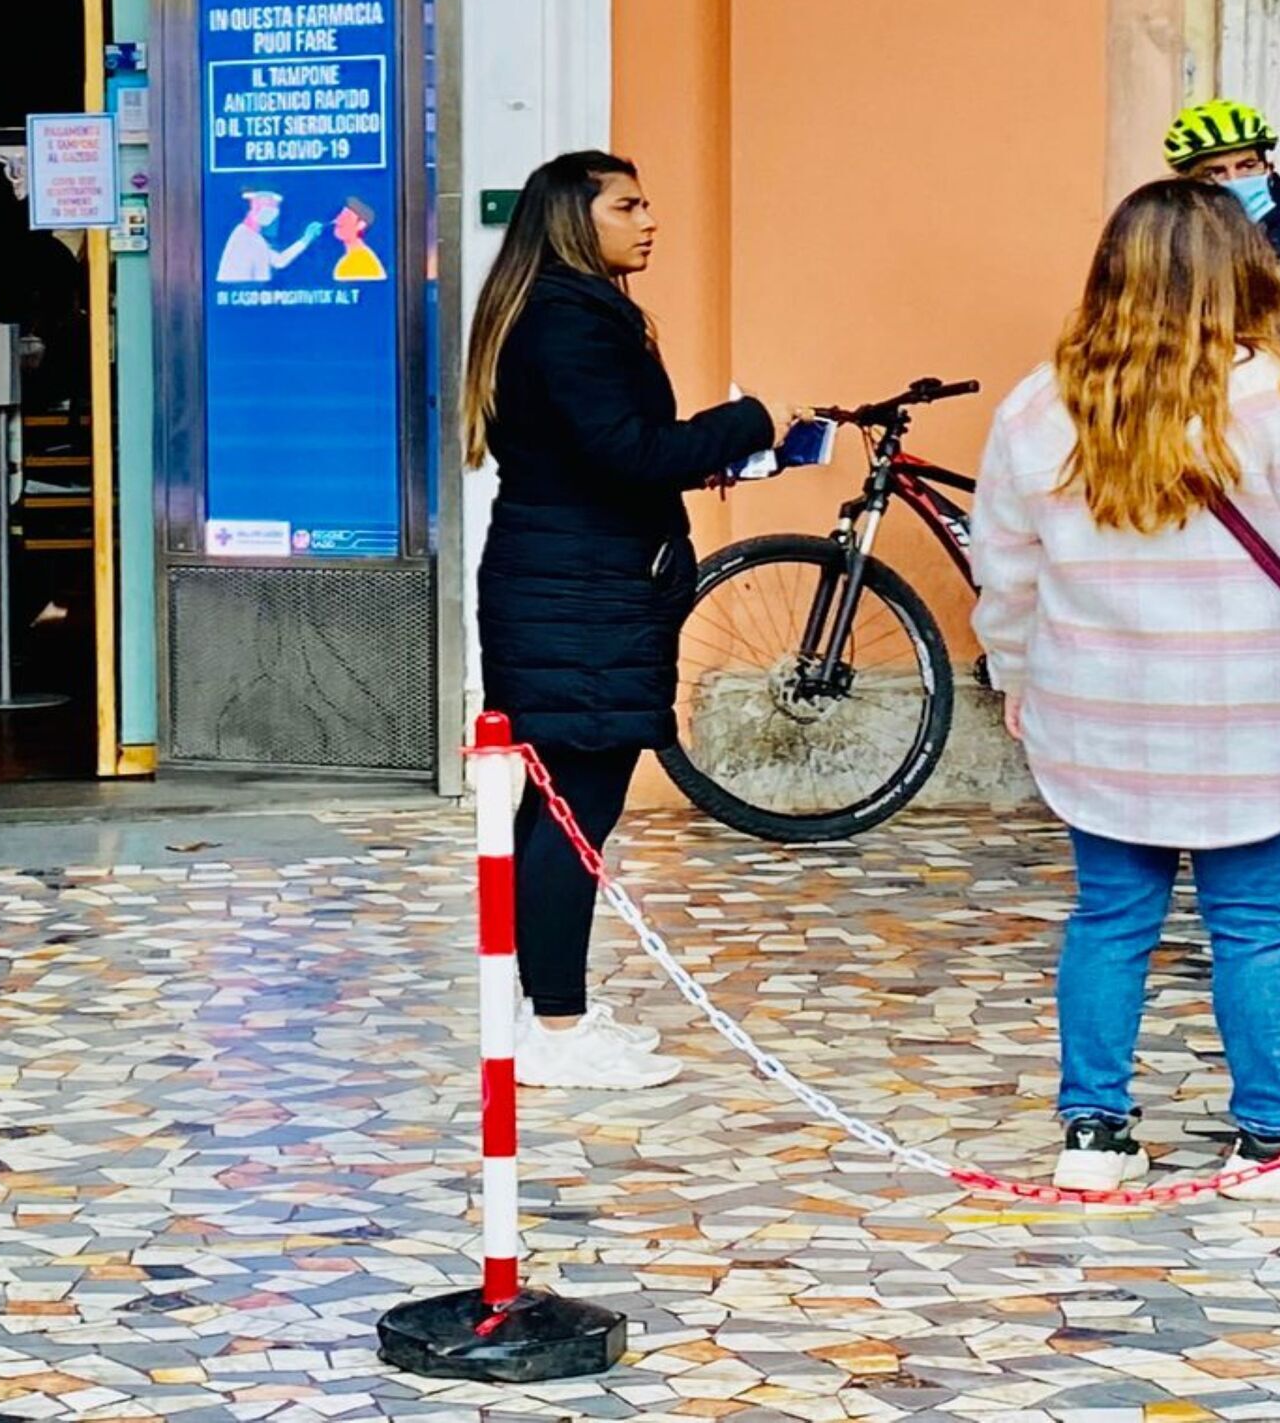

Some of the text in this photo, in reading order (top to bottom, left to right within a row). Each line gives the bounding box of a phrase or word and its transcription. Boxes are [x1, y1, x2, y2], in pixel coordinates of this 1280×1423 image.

[210, 2, 384, 31] IN QUESTA FARMACIA
[253, 29, 338, 54] PUOI FARE
[252, 65, 340, 87] IL TAMPONE
[224, 89, 369, 112] ANTIGENICO RAPIDO
[215, 113, 380, 137] O IL TEST SIEROLOGICO
[245, 141, 274, 161] PER
